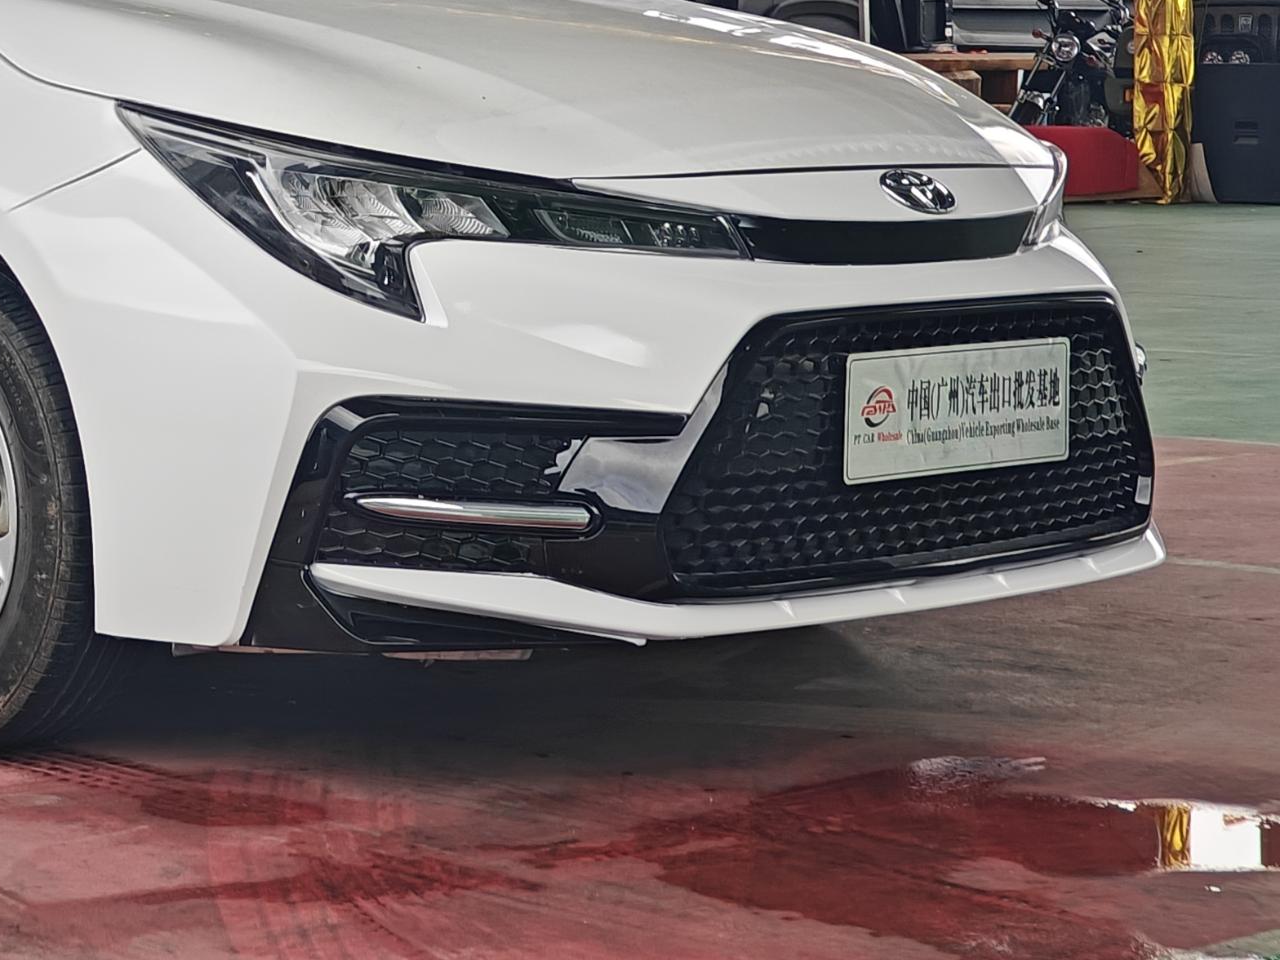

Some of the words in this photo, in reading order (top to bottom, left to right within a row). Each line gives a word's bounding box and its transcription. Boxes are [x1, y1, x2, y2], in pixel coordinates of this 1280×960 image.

[907, 367, 1061, 422] 中国(广州)汽车出口批发基地
